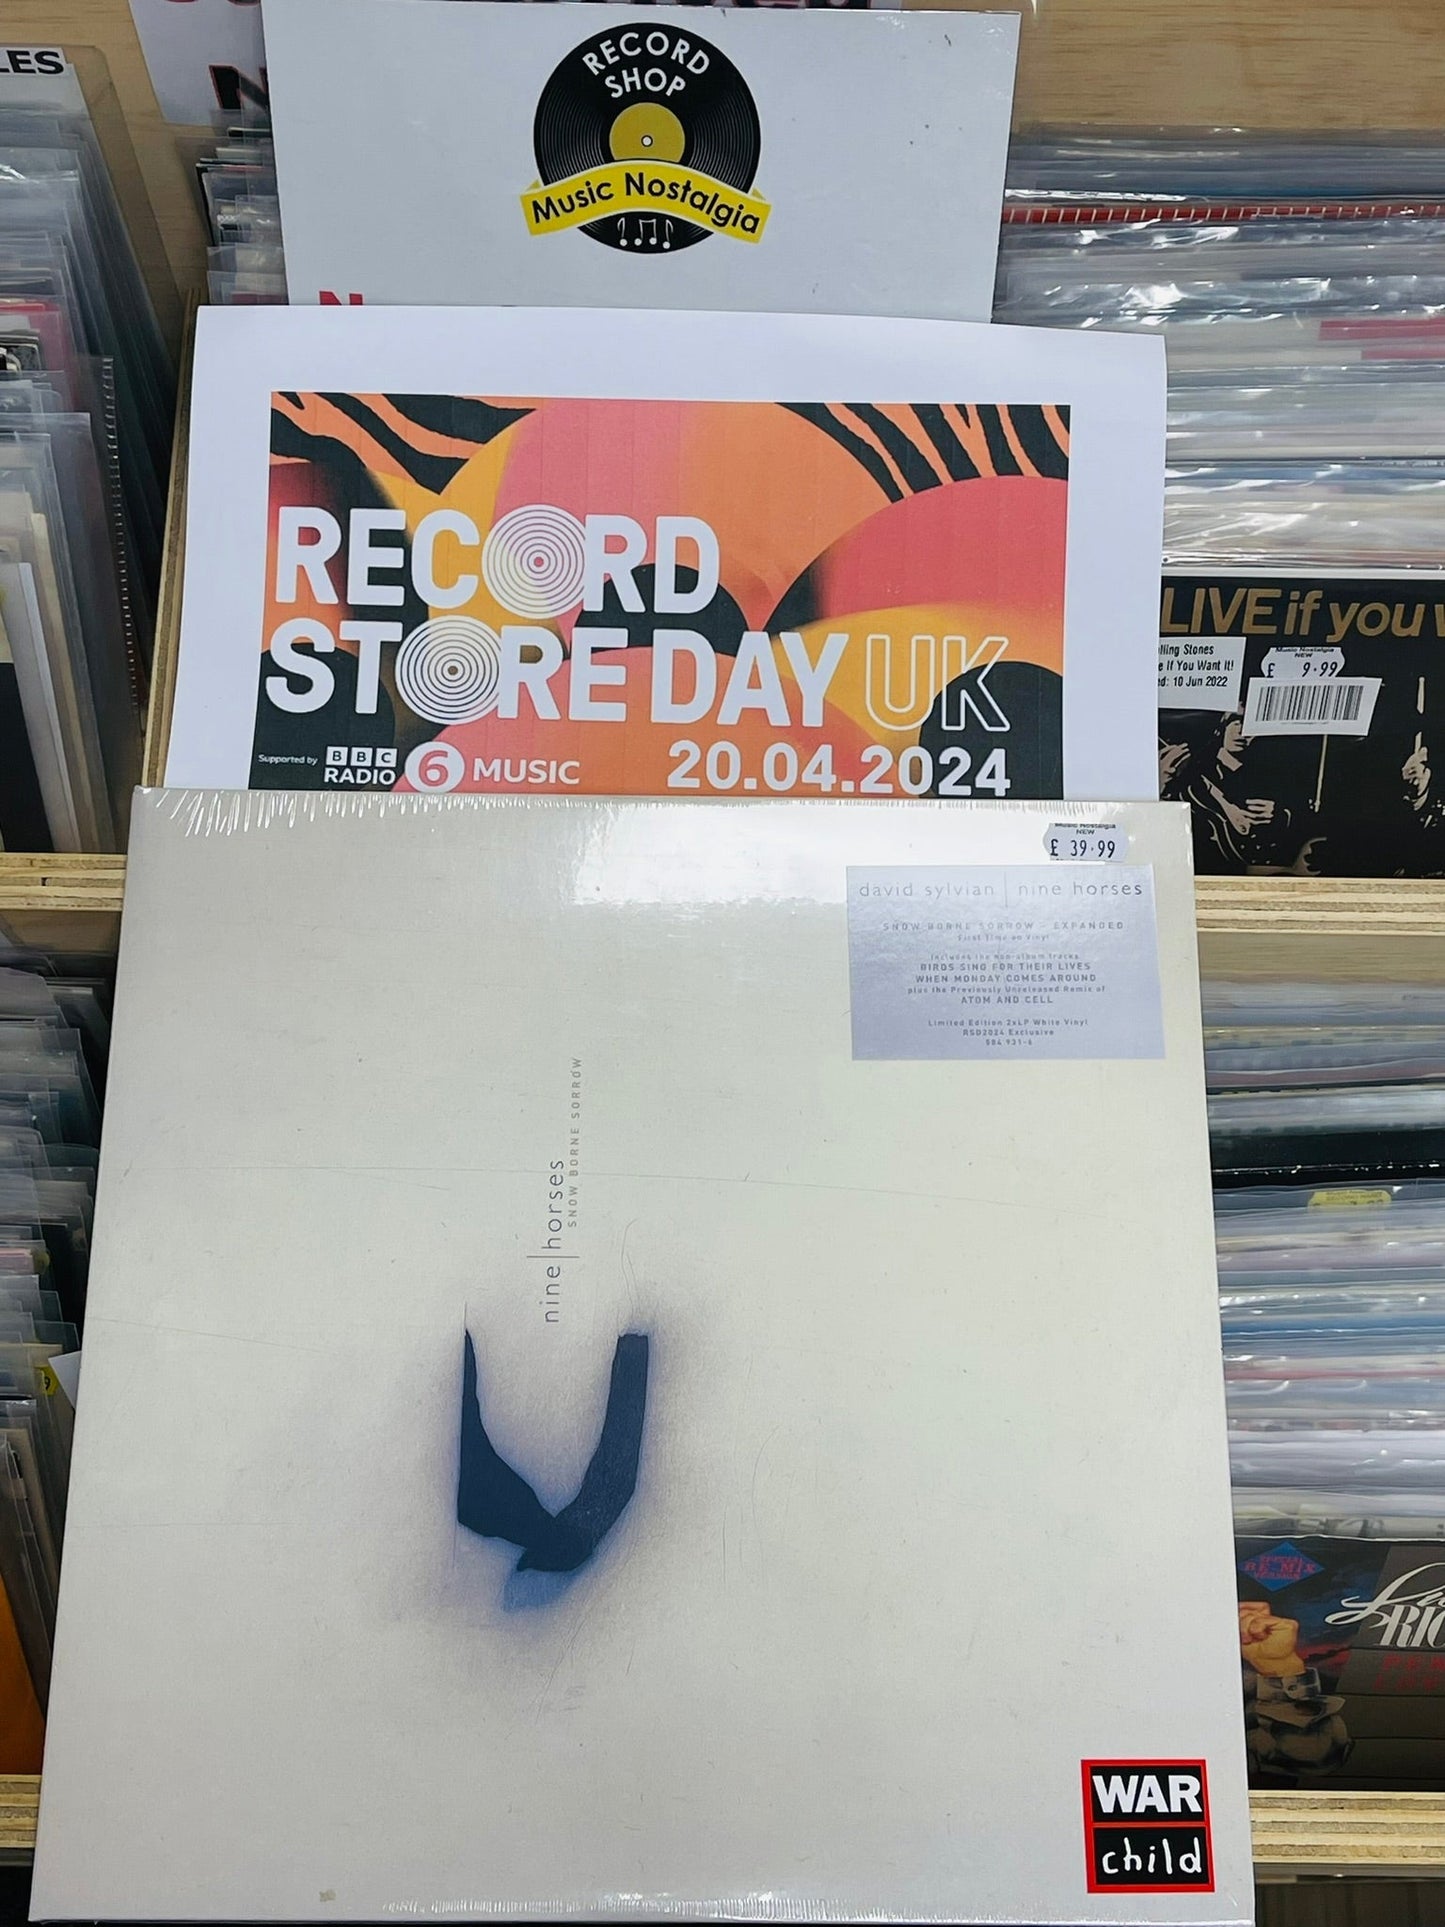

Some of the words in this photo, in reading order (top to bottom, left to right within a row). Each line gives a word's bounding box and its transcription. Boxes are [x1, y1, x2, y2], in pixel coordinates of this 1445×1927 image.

[583, 31, 710, 76] RECORD
[605, 67, 686, 98] SHOP
[532, 180, 614, 224] Music
[625, 172, 760, 234] Nostalgia
[275, 503, 720, 619] RECORD
[1160, 587, 1283, 634] LIVE
[1284, 590, 1323, 636] if
[1326, 602, 1426, 643] you
[1177, 660, 1195, 671] You
[1197, 660, 1221, 671] Want
[1224, 660, 1234, 671] It!
[1183, 643, 1215, 655] Stones
[265, 615, 629, 725] STORE
[651, 629, 849, 727] DAY
[865, 633, 1011, 732] UK
[1173, 676, 1184, 687] 10
[1185, 676, 1203, 687] Jun
[1205, 676, 1228, 687] 2022
[258, 754, 305, 765] Supported
[306, 757, 318, 766] by
[329, 748, 394, 765] BBC
[415, 747, 453, 788] 6
[472, 756, 580, 785] MUSIC
[667, 739, 1011, 797] 20.04.2024
[324, 767, 396, 785] RADIO
[859, 882, 913, 897] david
[924, 882, 995, 900] sylvian
[1018, 882, 1062, 897] nine
[1073, 880, 1143, 896] horses
[883, 922, 920, 931] SNOW
[979, 921, 1034, 930] SORROW
[1054, 921, 1124, 930] EXPANDED
[916, 975, 948, 983] WHEN
[954, 975, 1001, 983] MONDAY
[1006, 974, 1044, 982] COMES
[1050, 974, 1096, 982] AROUND
[920, 963, 955, 971] BIRDS
[960, 963, 987, 971] SING
[992, 963, 1014, 971] FOR
[1019, 962, 1053, 971] THEIR
[1058, 962, 1091, 971] LIVES
[951, 986, 1001, 994] Previously
[961, 996, 991, 1004] ATOM
[996, 996, 1020, 1004] AND
[1063, 1019, 1088, 1027] Vinyl
[571, 1057, 582, 1119] SORROW
[569, 1127, 580, 1177] BORNE
[541, 1159, 564, 1250] horses
[568, 1185, 579, 1228] SNOW
[538, 1265, 562, 1323] nine
[1092, 1774, 1202, 1814] WAR
[1102, 1837, 1202, 1875] child
